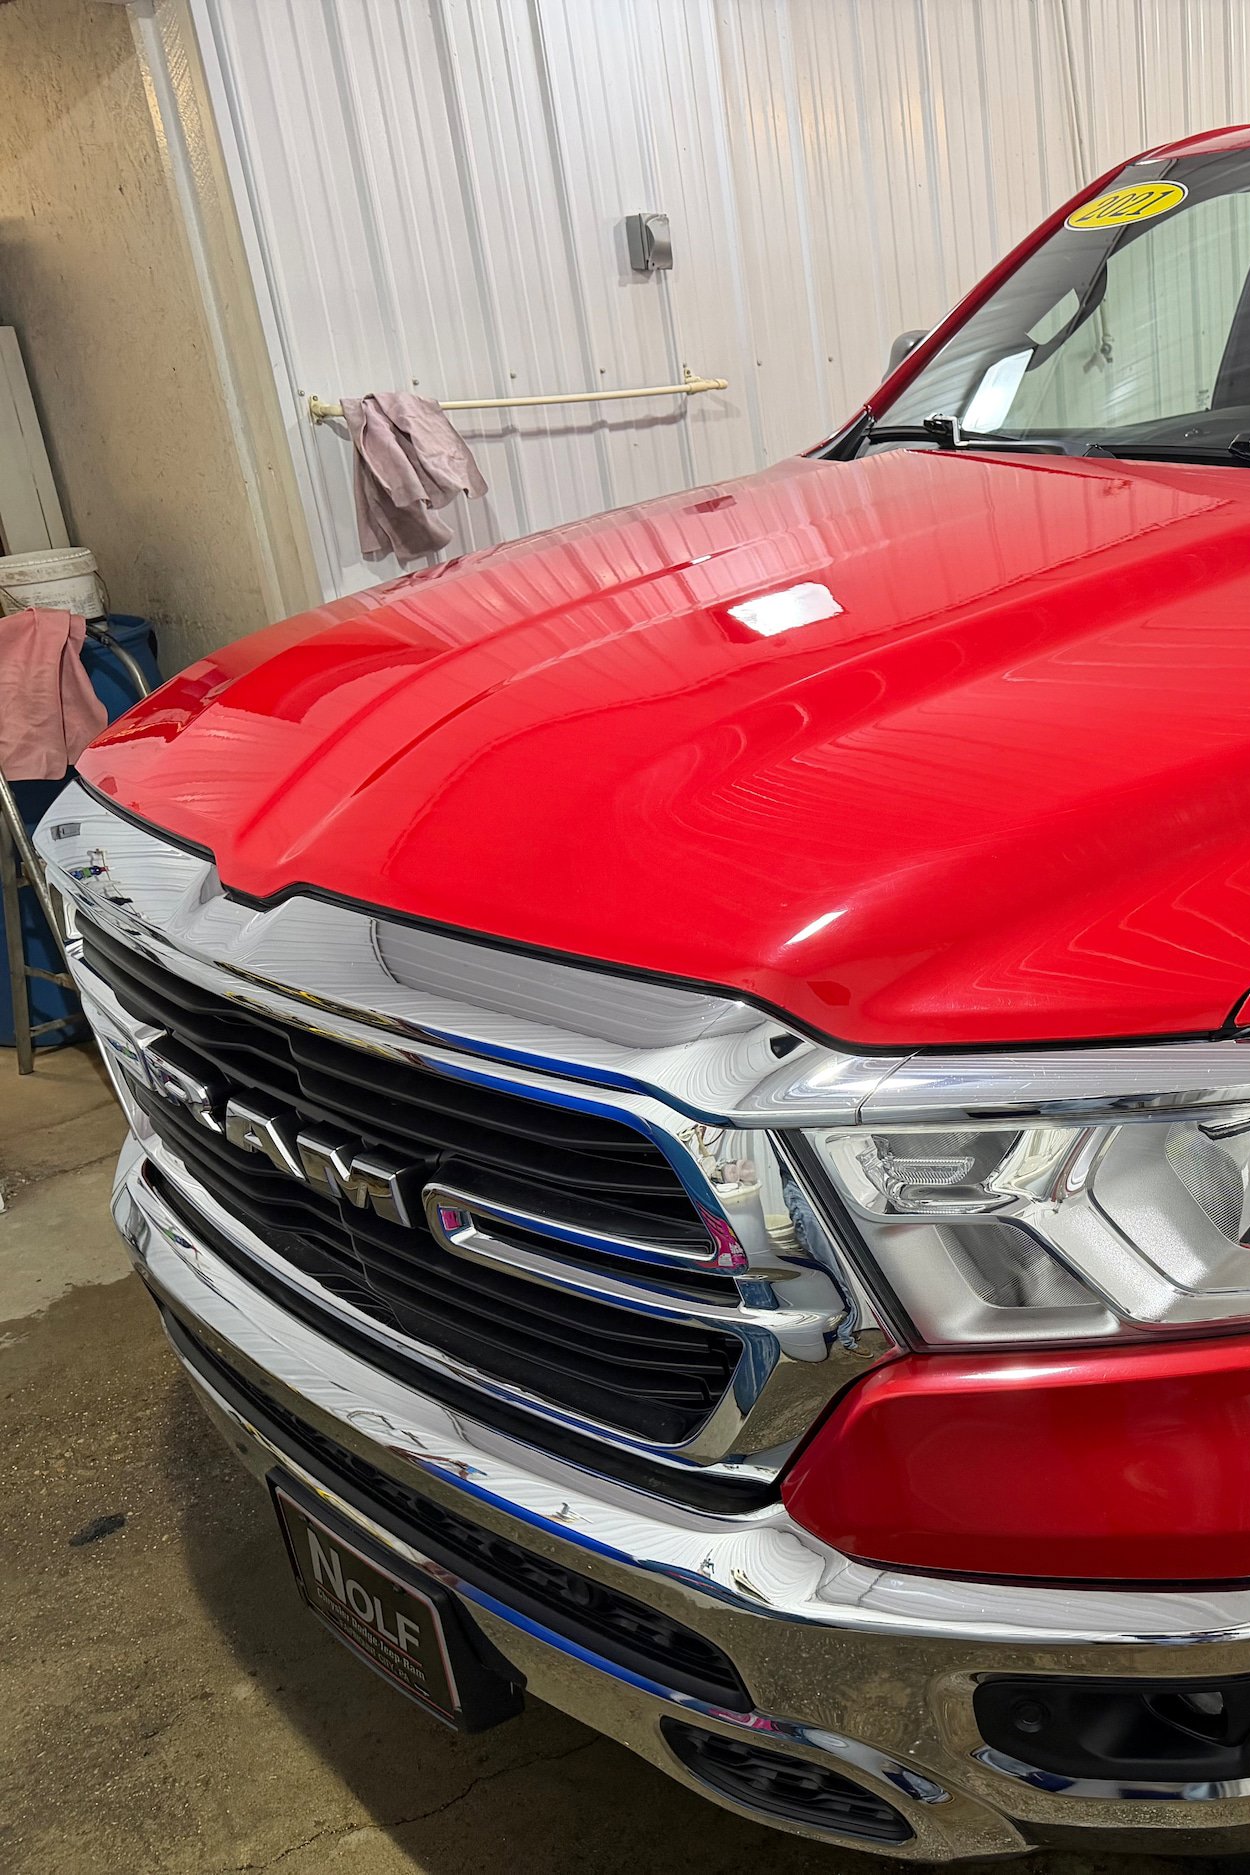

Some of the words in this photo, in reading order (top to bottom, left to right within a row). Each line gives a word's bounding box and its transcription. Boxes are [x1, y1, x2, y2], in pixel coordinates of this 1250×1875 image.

[1075, 189, 1176, 223] 2021
[146, 1036, 416, 1228] RAM
[307, 1527, 420, 1652] NOLF
